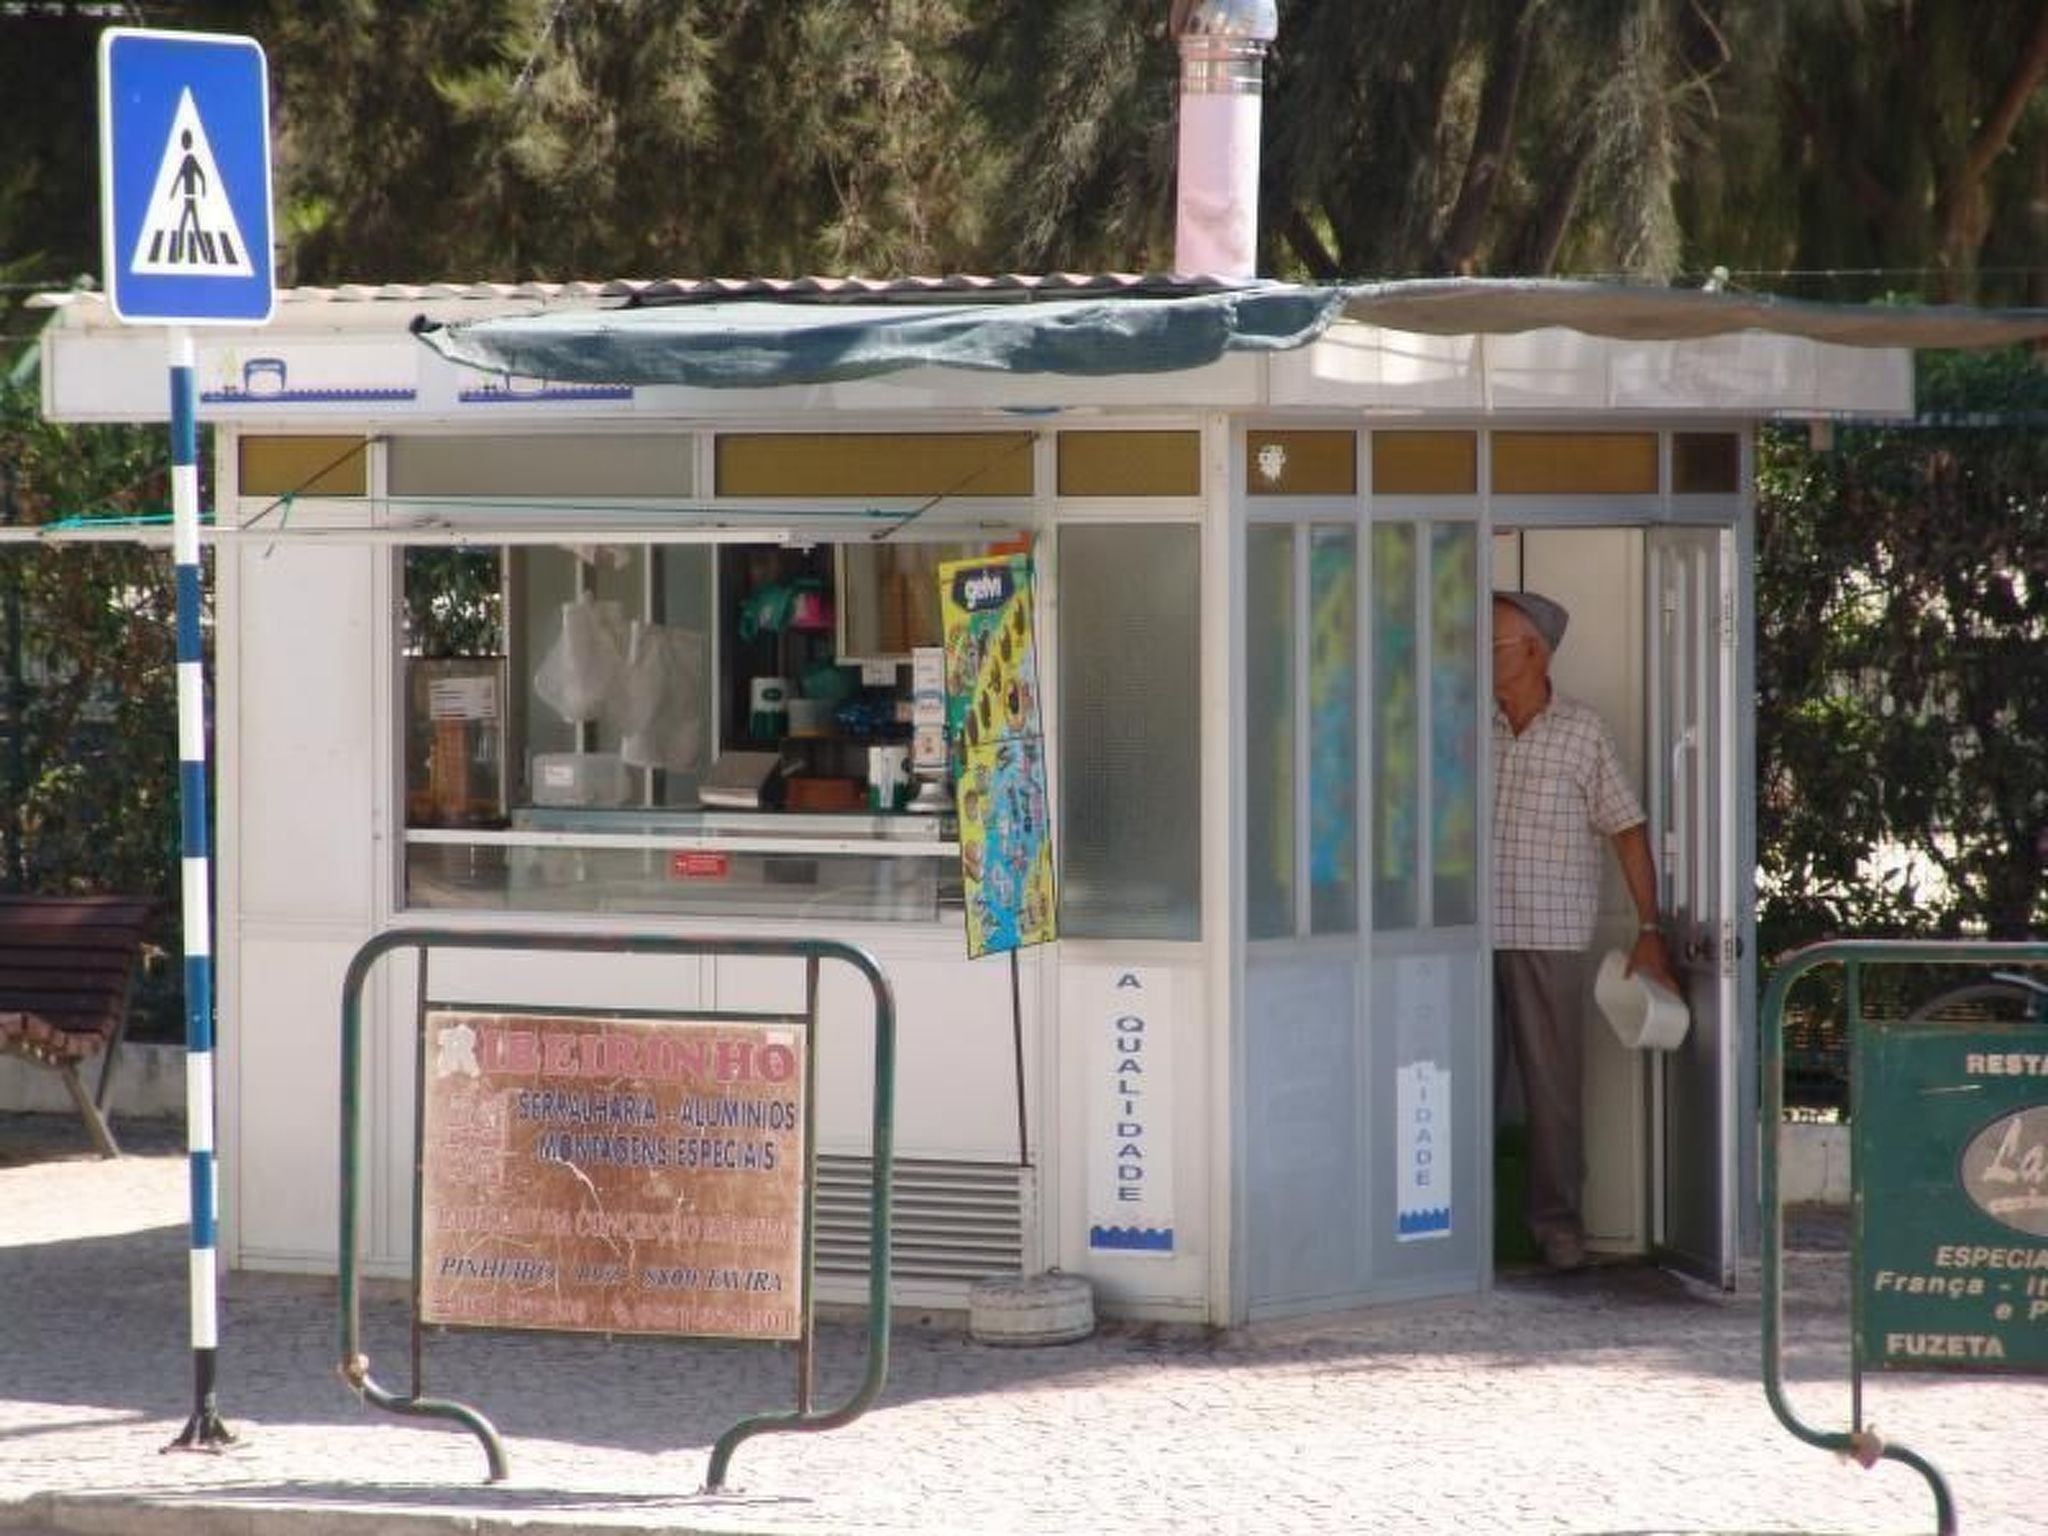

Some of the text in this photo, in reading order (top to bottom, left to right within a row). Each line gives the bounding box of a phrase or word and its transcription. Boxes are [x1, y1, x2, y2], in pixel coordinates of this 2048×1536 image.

[1115, 973, 1145, 1202] A QUALIDADE
[676, 1137, 777, 1171] ESPECIAIS
[1874, 1270, 1985, 1299] França
[1994, 1303, 2013, 1321] e
[1886, 1333, 2007, 1357] FUZETA
